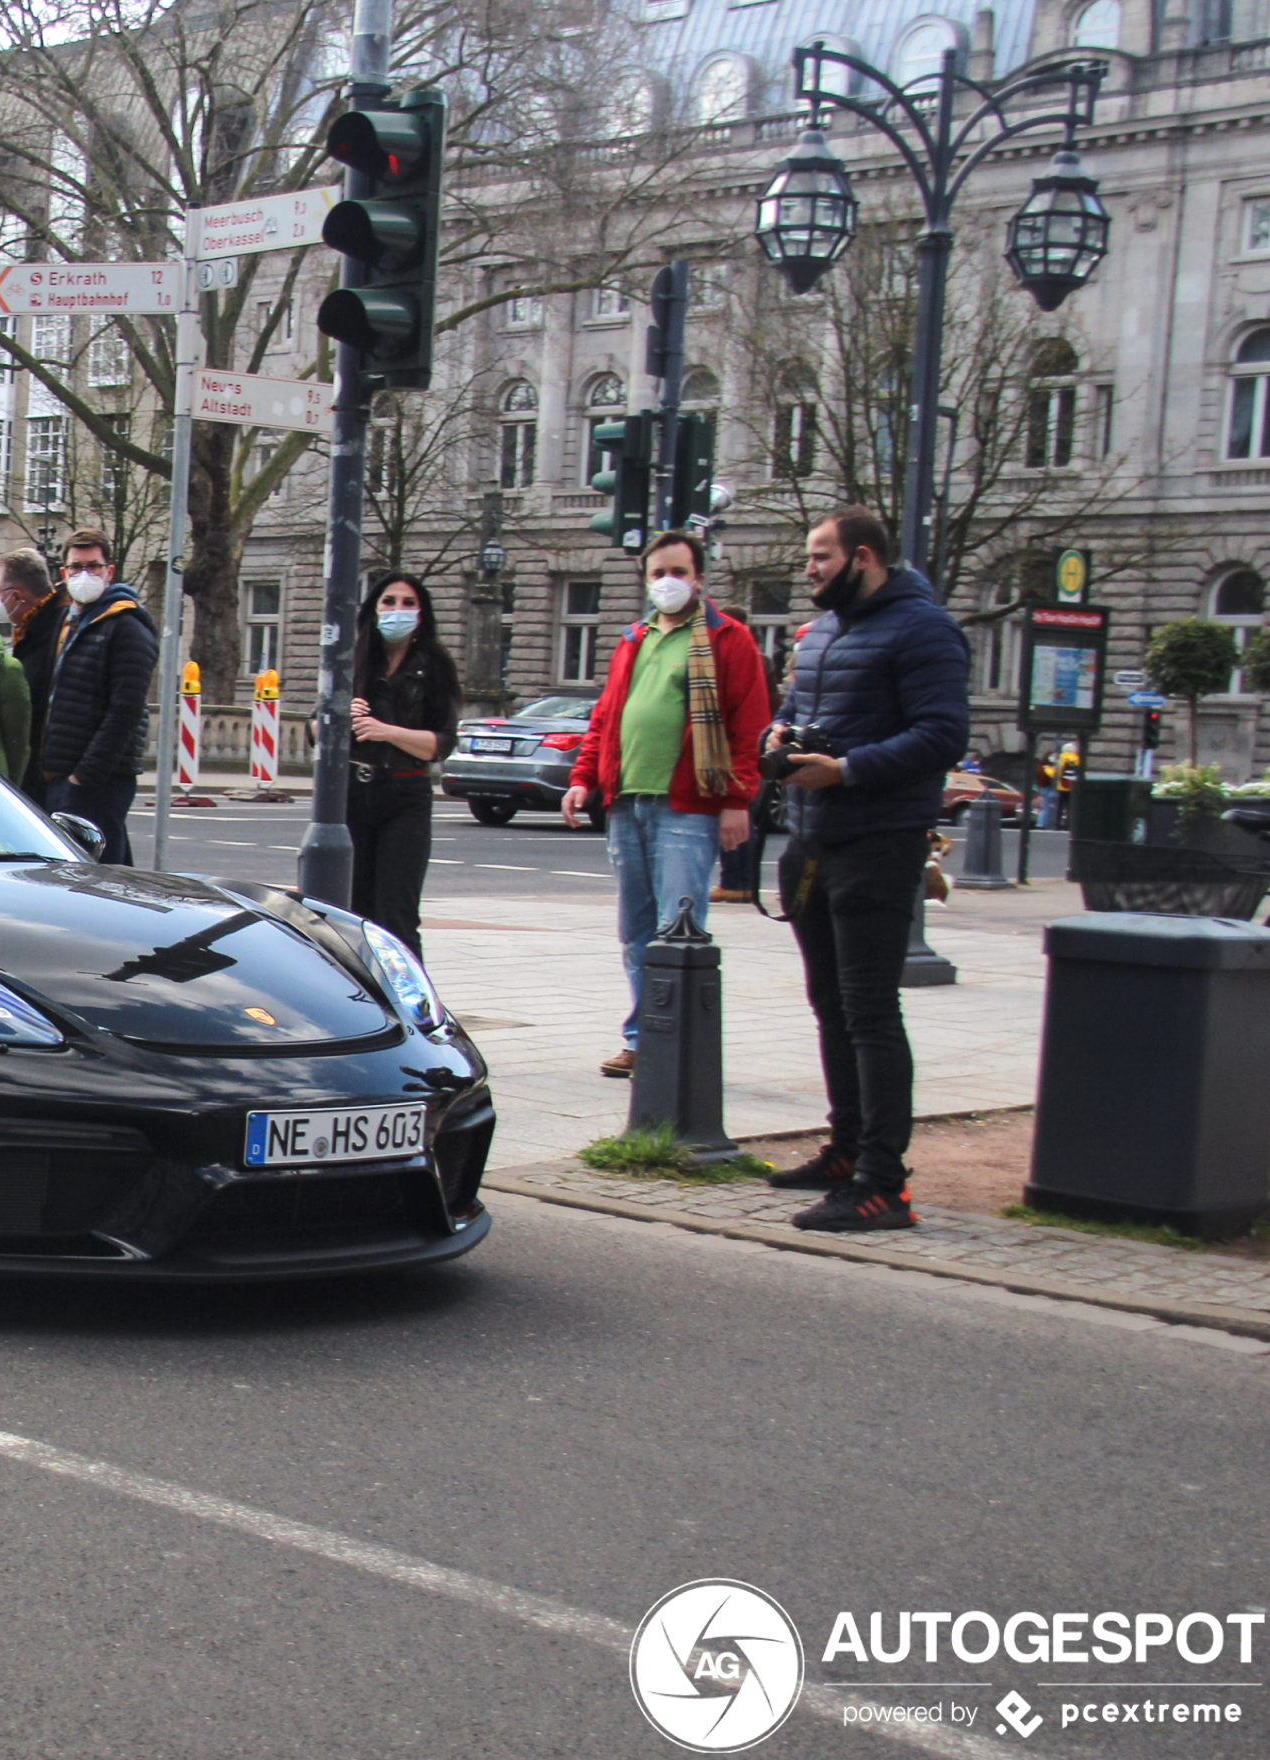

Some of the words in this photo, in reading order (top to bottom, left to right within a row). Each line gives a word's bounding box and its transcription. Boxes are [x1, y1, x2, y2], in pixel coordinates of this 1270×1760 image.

[204, 207, 264, 229] Meerbusch
[204, 231, 264, 251] Oberkassel
[49, 271, 107, 286] Erkrath
[151, 270, 163, 284] 12
[48, 292, 128, 309] Hauptbahnhof
[201, 398, 252, 417] Altstadt
[252, 1144, 260, 1155] D
[268, 1119, 310, 1157] NE
[331, 1115, 369, 1154] HS
[376, 1110, 422, 1150] 603
